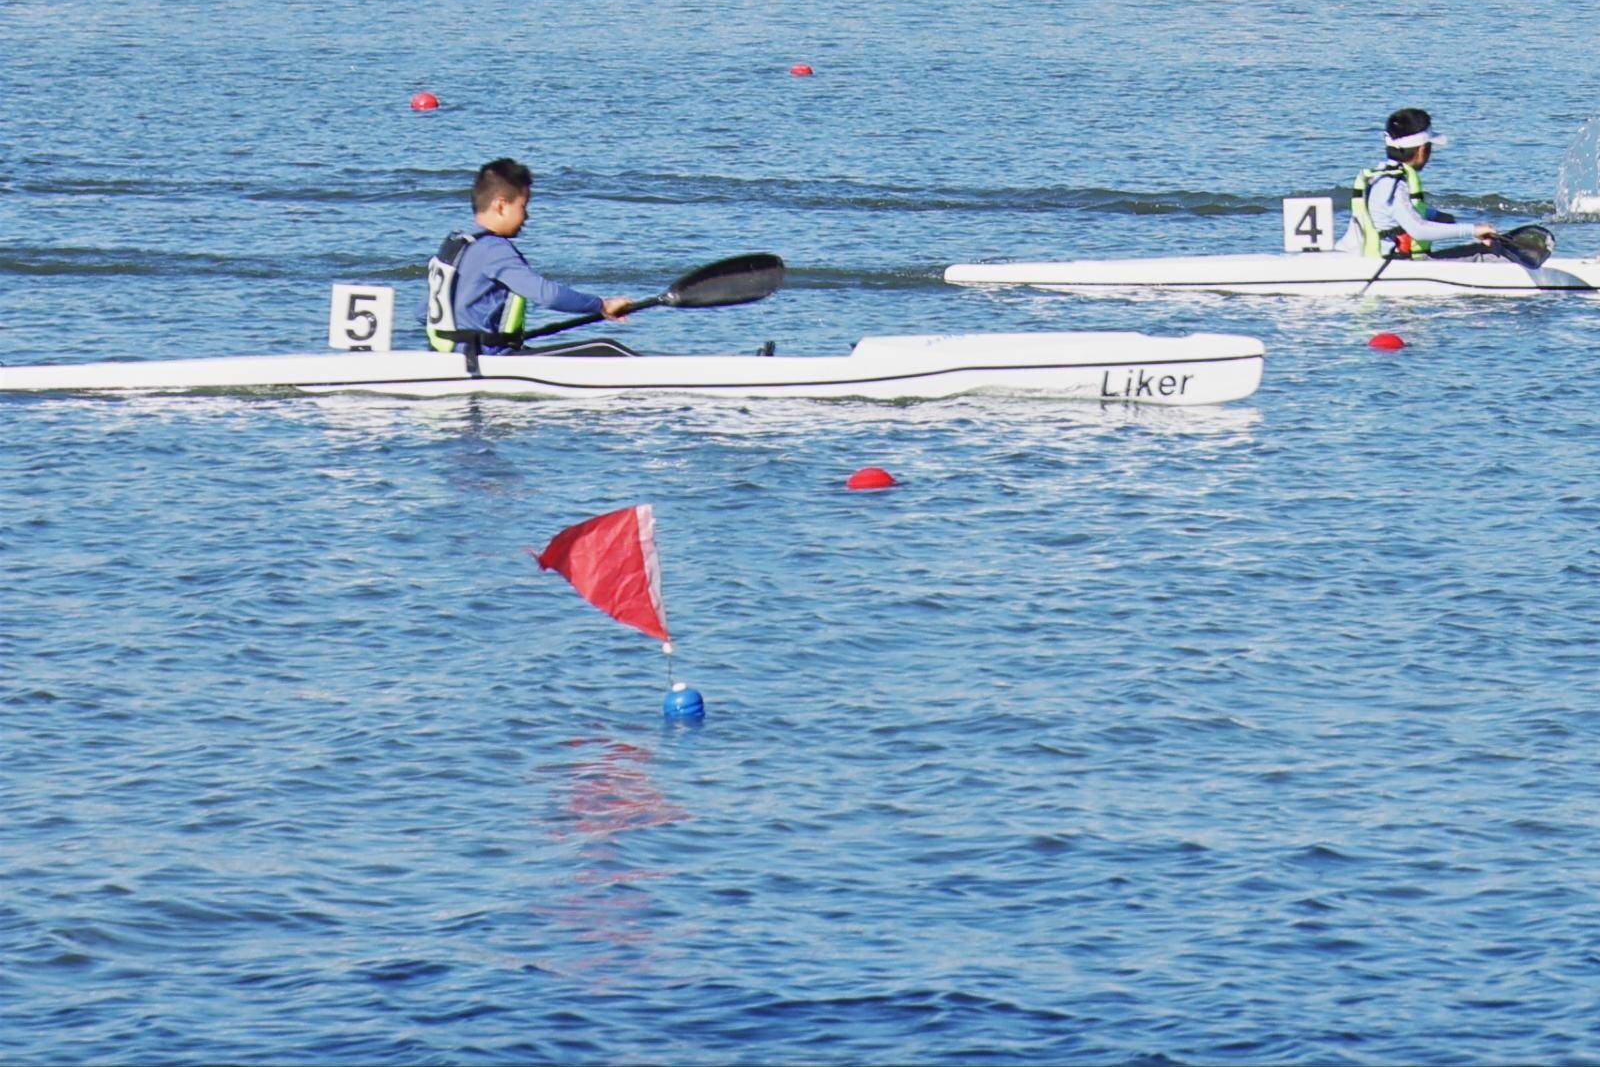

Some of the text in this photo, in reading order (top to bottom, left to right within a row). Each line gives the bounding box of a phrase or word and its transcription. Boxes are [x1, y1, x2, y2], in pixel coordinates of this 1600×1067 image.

[1295, 205, 1322, 244] 4
[346, 294, 377, 341] 5
[1101, 369, 1194, 397] Liker
